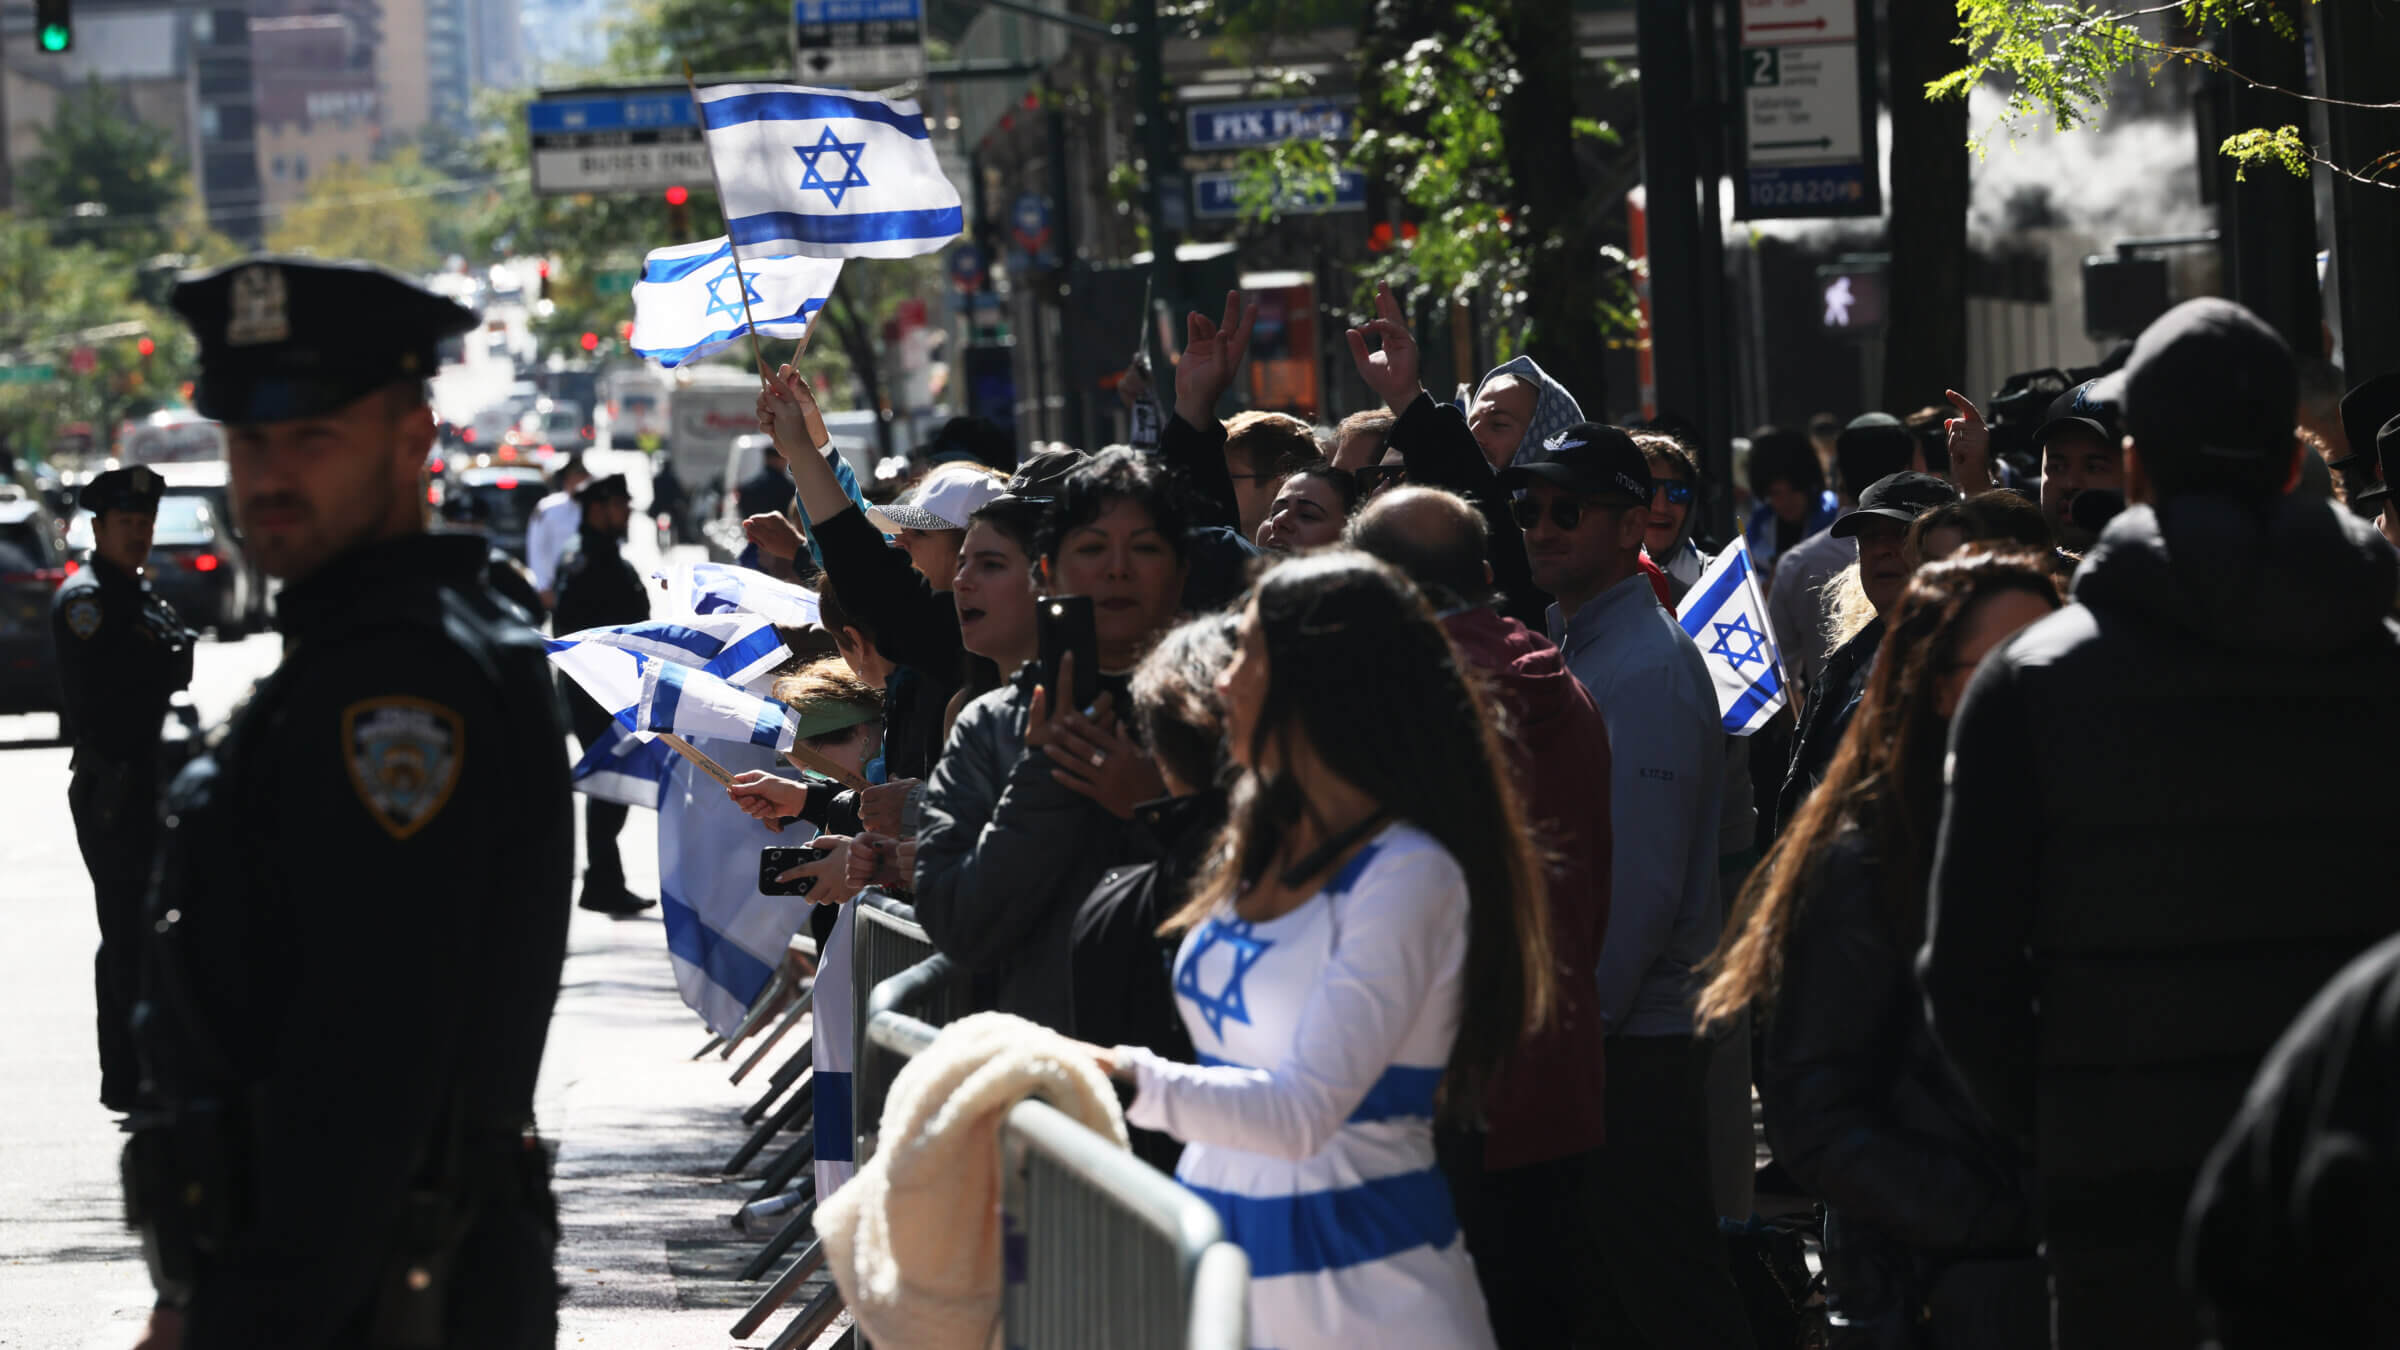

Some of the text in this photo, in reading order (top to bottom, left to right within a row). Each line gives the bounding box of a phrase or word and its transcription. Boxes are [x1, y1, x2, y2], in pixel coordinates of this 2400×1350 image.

[1753, 51, 1773, 84] 2
[625, 101, 671, 126] BUS
[581, 152, 650, 173] BUSES
